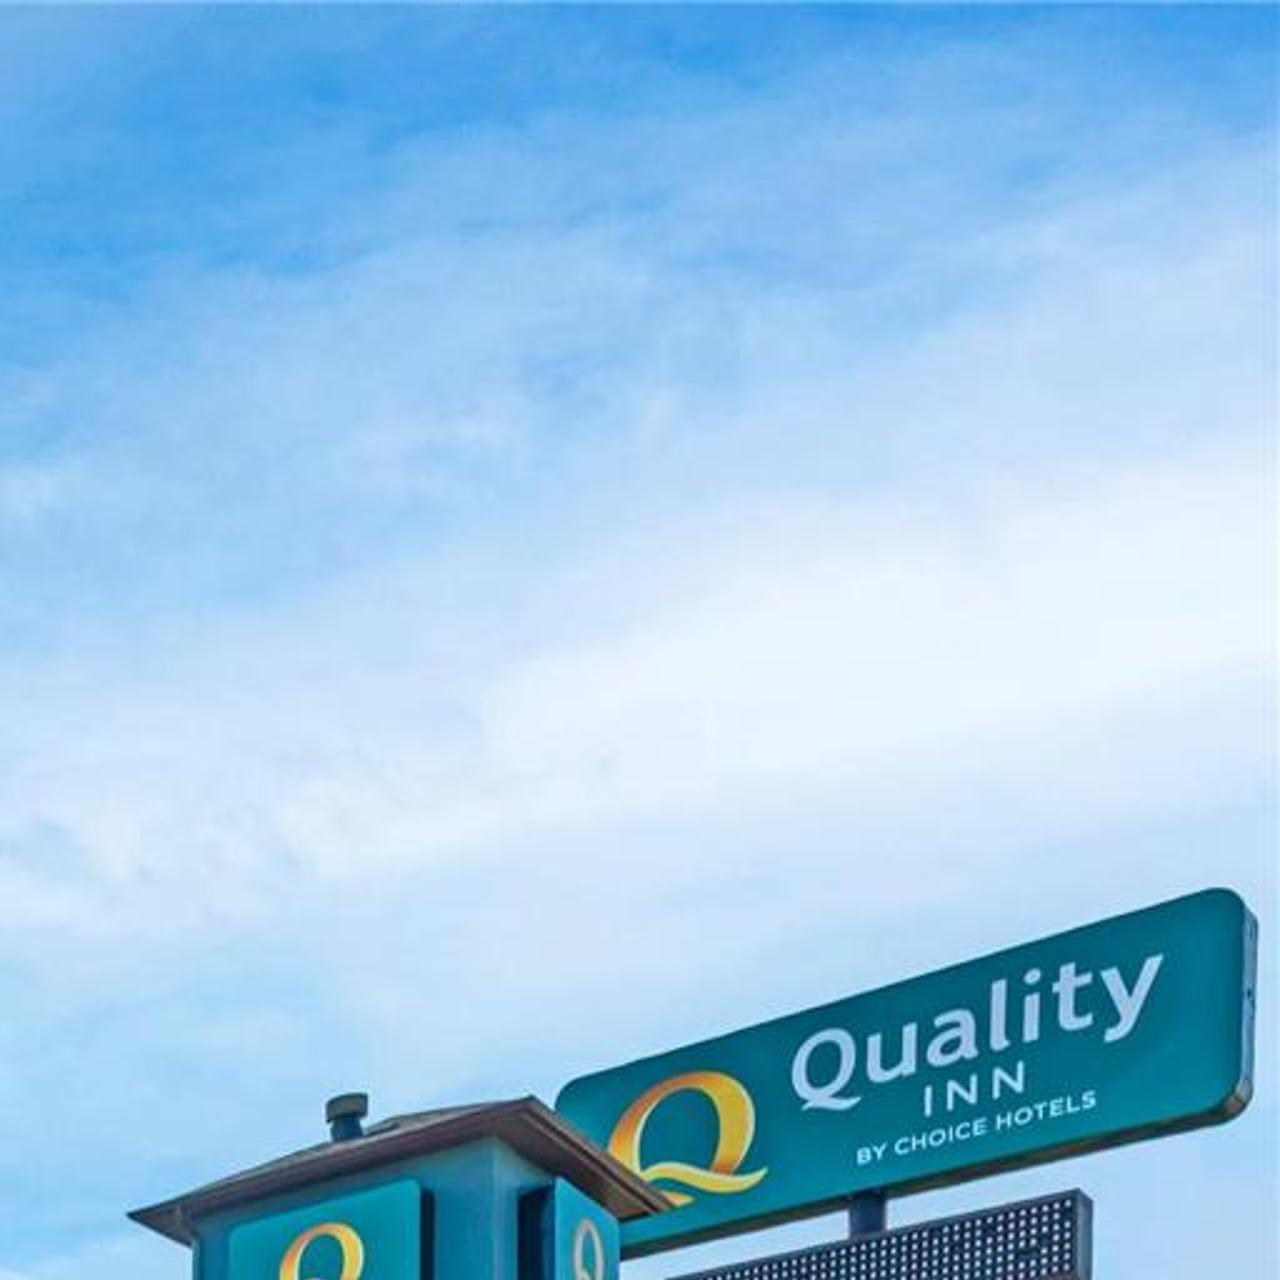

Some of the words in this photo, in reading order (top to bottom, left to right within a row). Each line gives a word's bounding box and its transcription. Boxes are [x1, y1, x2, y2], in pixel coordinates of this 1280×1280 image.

[790, 953, 1165, 1111] Quality
[607, 1070, 768, 1206] Q
[856, 1141, 888, 1167] BY
[894, 1116, 989, 1156] CHOICE
[995, 1090, 1098, 1131] HOTELS
[923, 1060, 1026, 1118] INN
